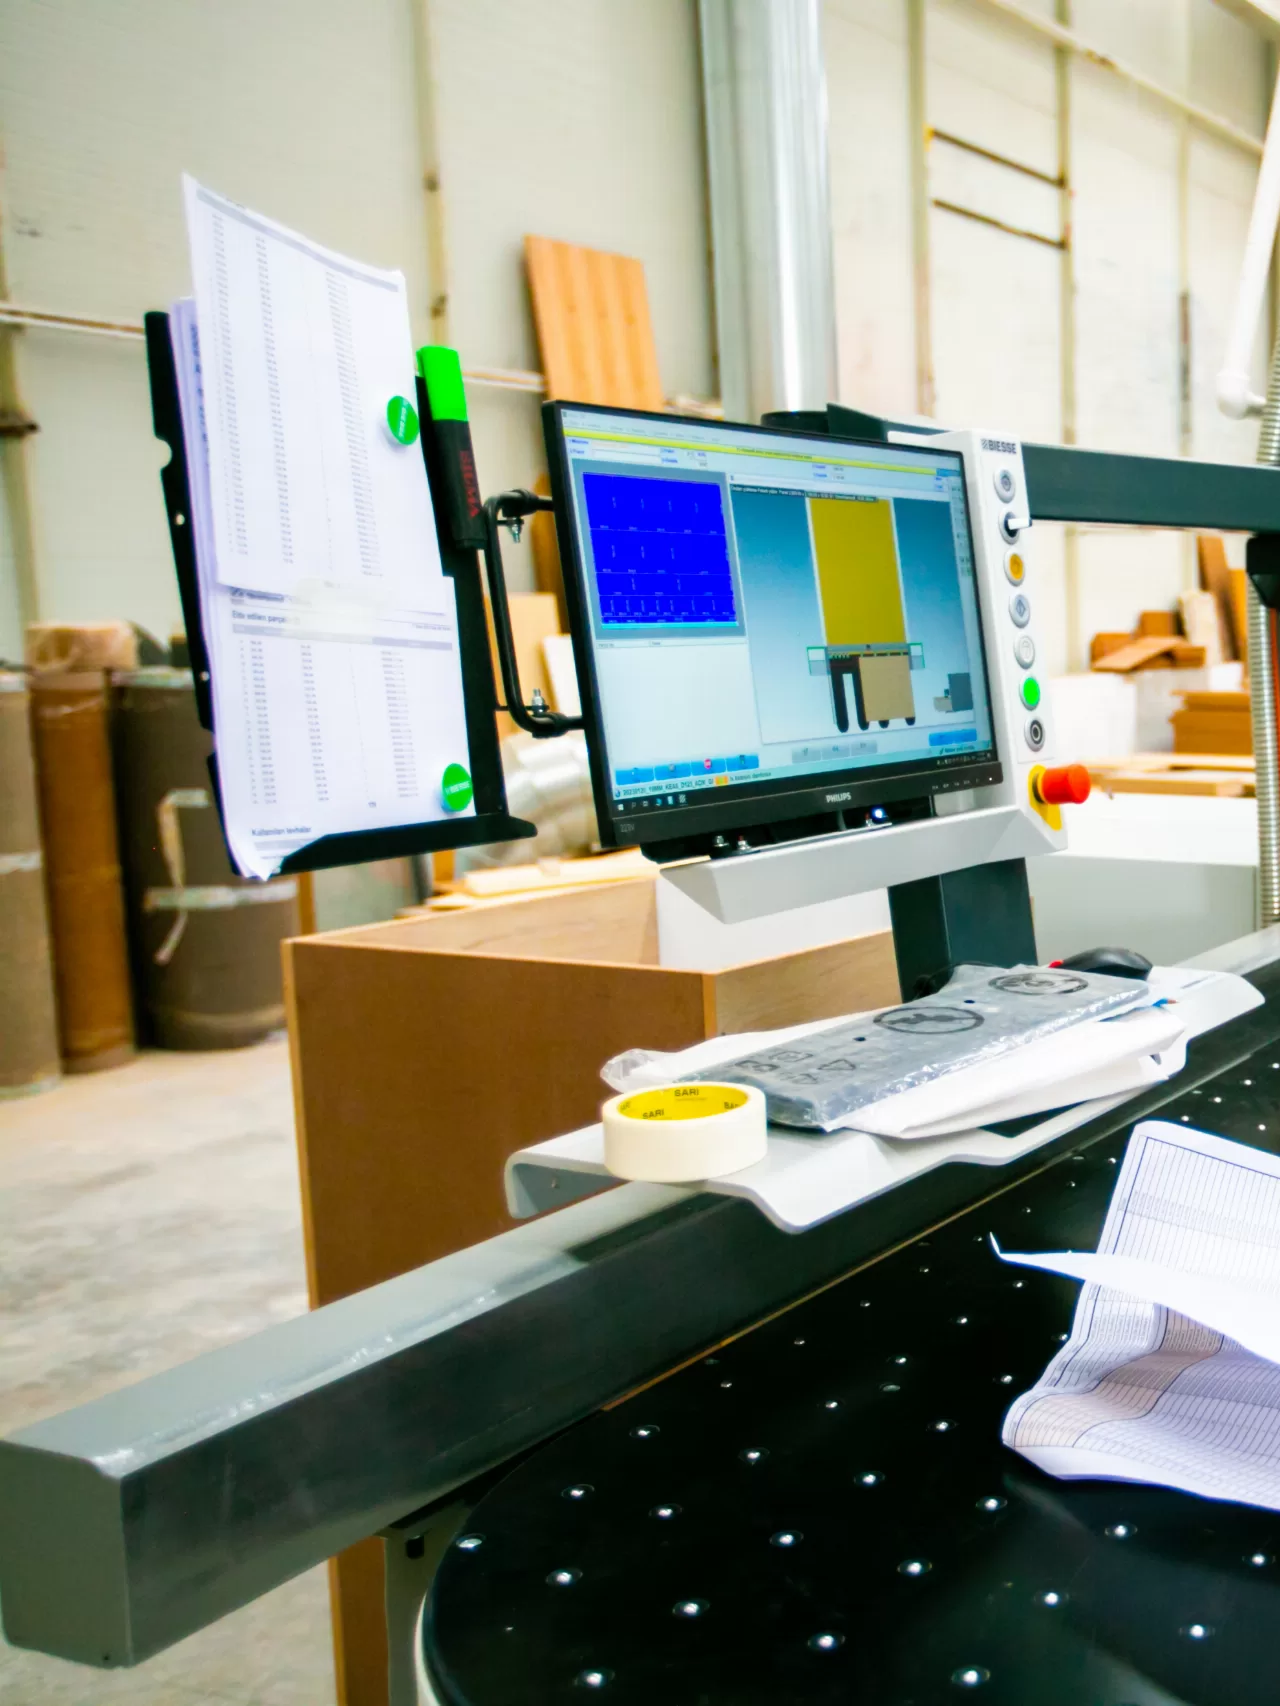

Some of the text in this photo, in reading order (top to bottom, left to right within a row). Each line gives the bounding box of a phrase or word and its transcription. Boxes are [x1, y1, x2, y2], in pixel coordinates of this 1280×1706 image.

[988, 439, 1017, 454] BIESSE
[825, 791, 852, 804] PHILIPS
[674, 1088, 700, 1097] SARI
[642, 1109, 665, 1120] SARI
